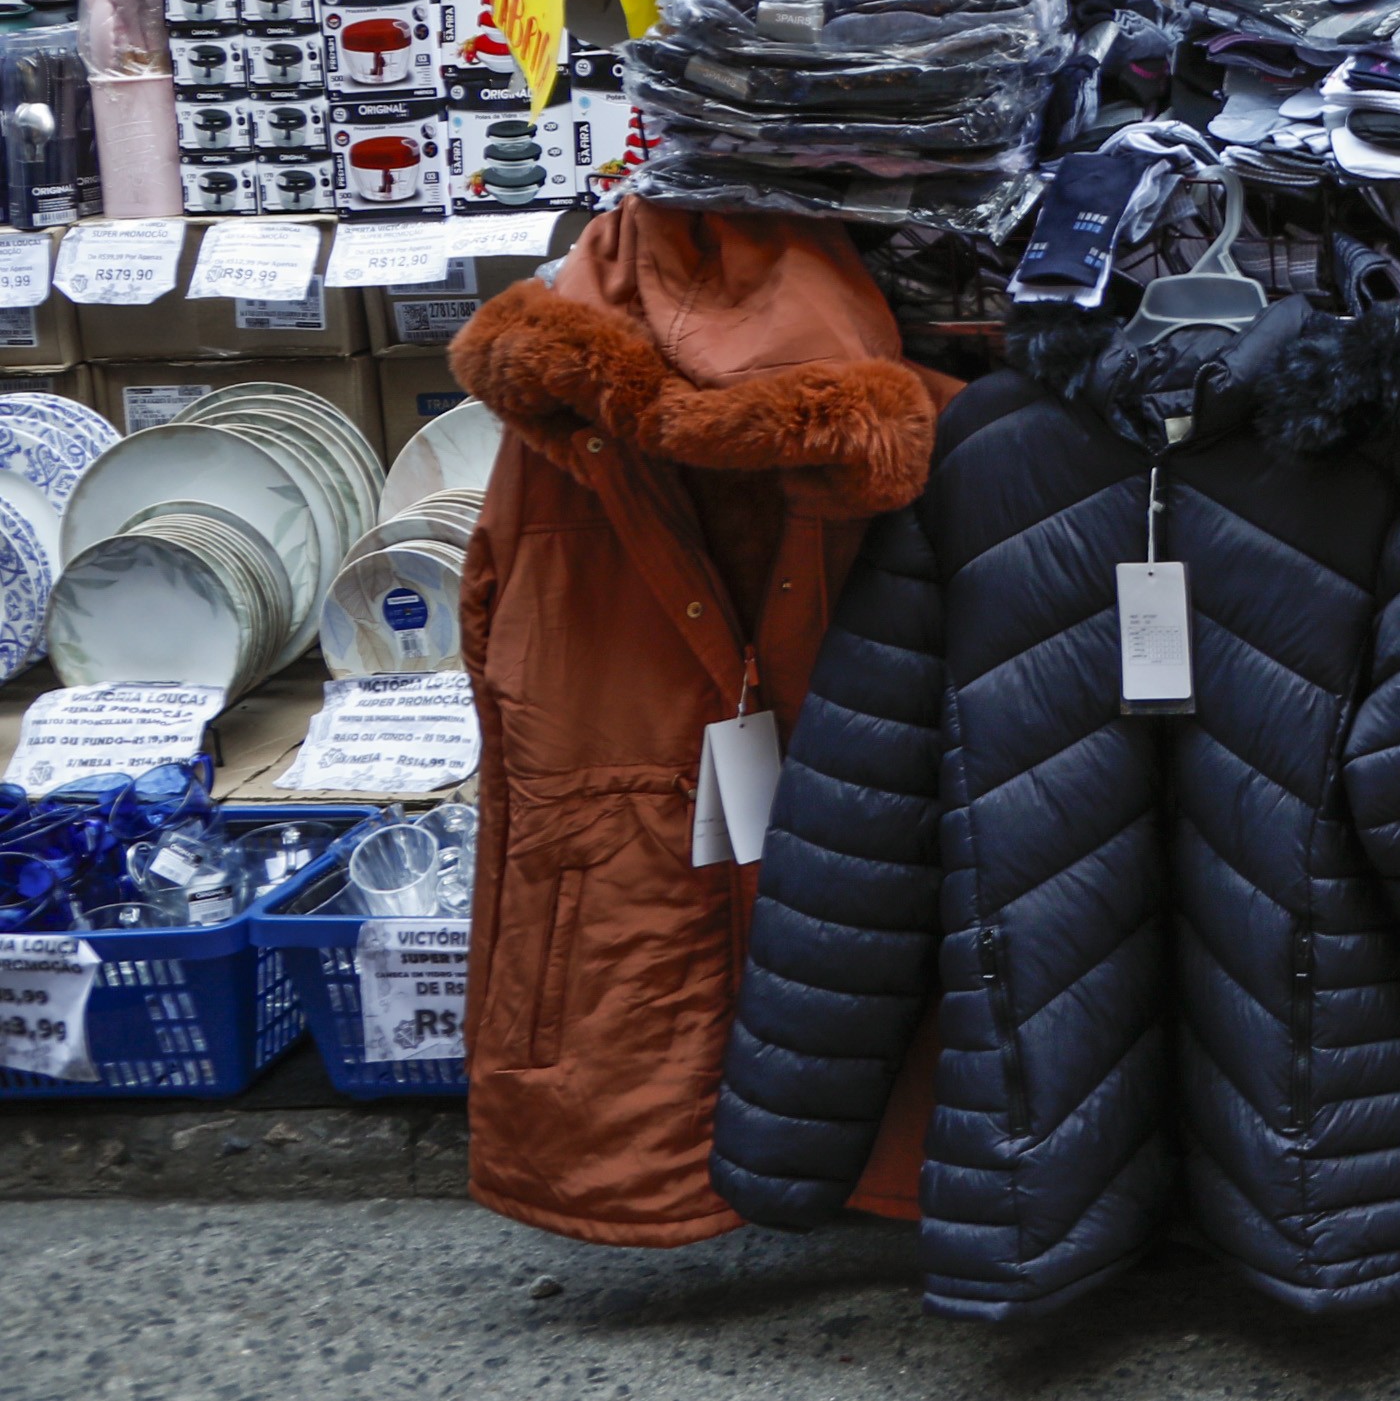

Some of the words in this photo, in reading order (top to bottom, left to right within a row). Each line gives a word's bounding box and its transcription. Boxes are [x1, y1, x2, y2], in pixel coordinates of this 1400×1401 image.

[445, 6, 455, 42] SAFIRA
[775, 13, 812, 26] 3PAIRS
[358, 103, 407, 115] ORIGINAL
[580, 123, 592, 165] SAFIRA
[452, 138, 462, 176] SAFIRA
[32, 184, 75, 196] ORIGINAL
[119, 229, 168, 238] PROMOÇÃO
[367, 253, 429, 268] R$12,90
[95, 268, 154, 282] R$79,90
[222, 267, 277, 282] R$9,99
[149, 692, 208, 707] LOUÇAS
[397, 693, 472, 707] PROMOÇÃO
[398, 927, 467, 945] VICTÓRI
[401, 953, 451, 964] SUPER
[416, 981, 440, 996] DE
